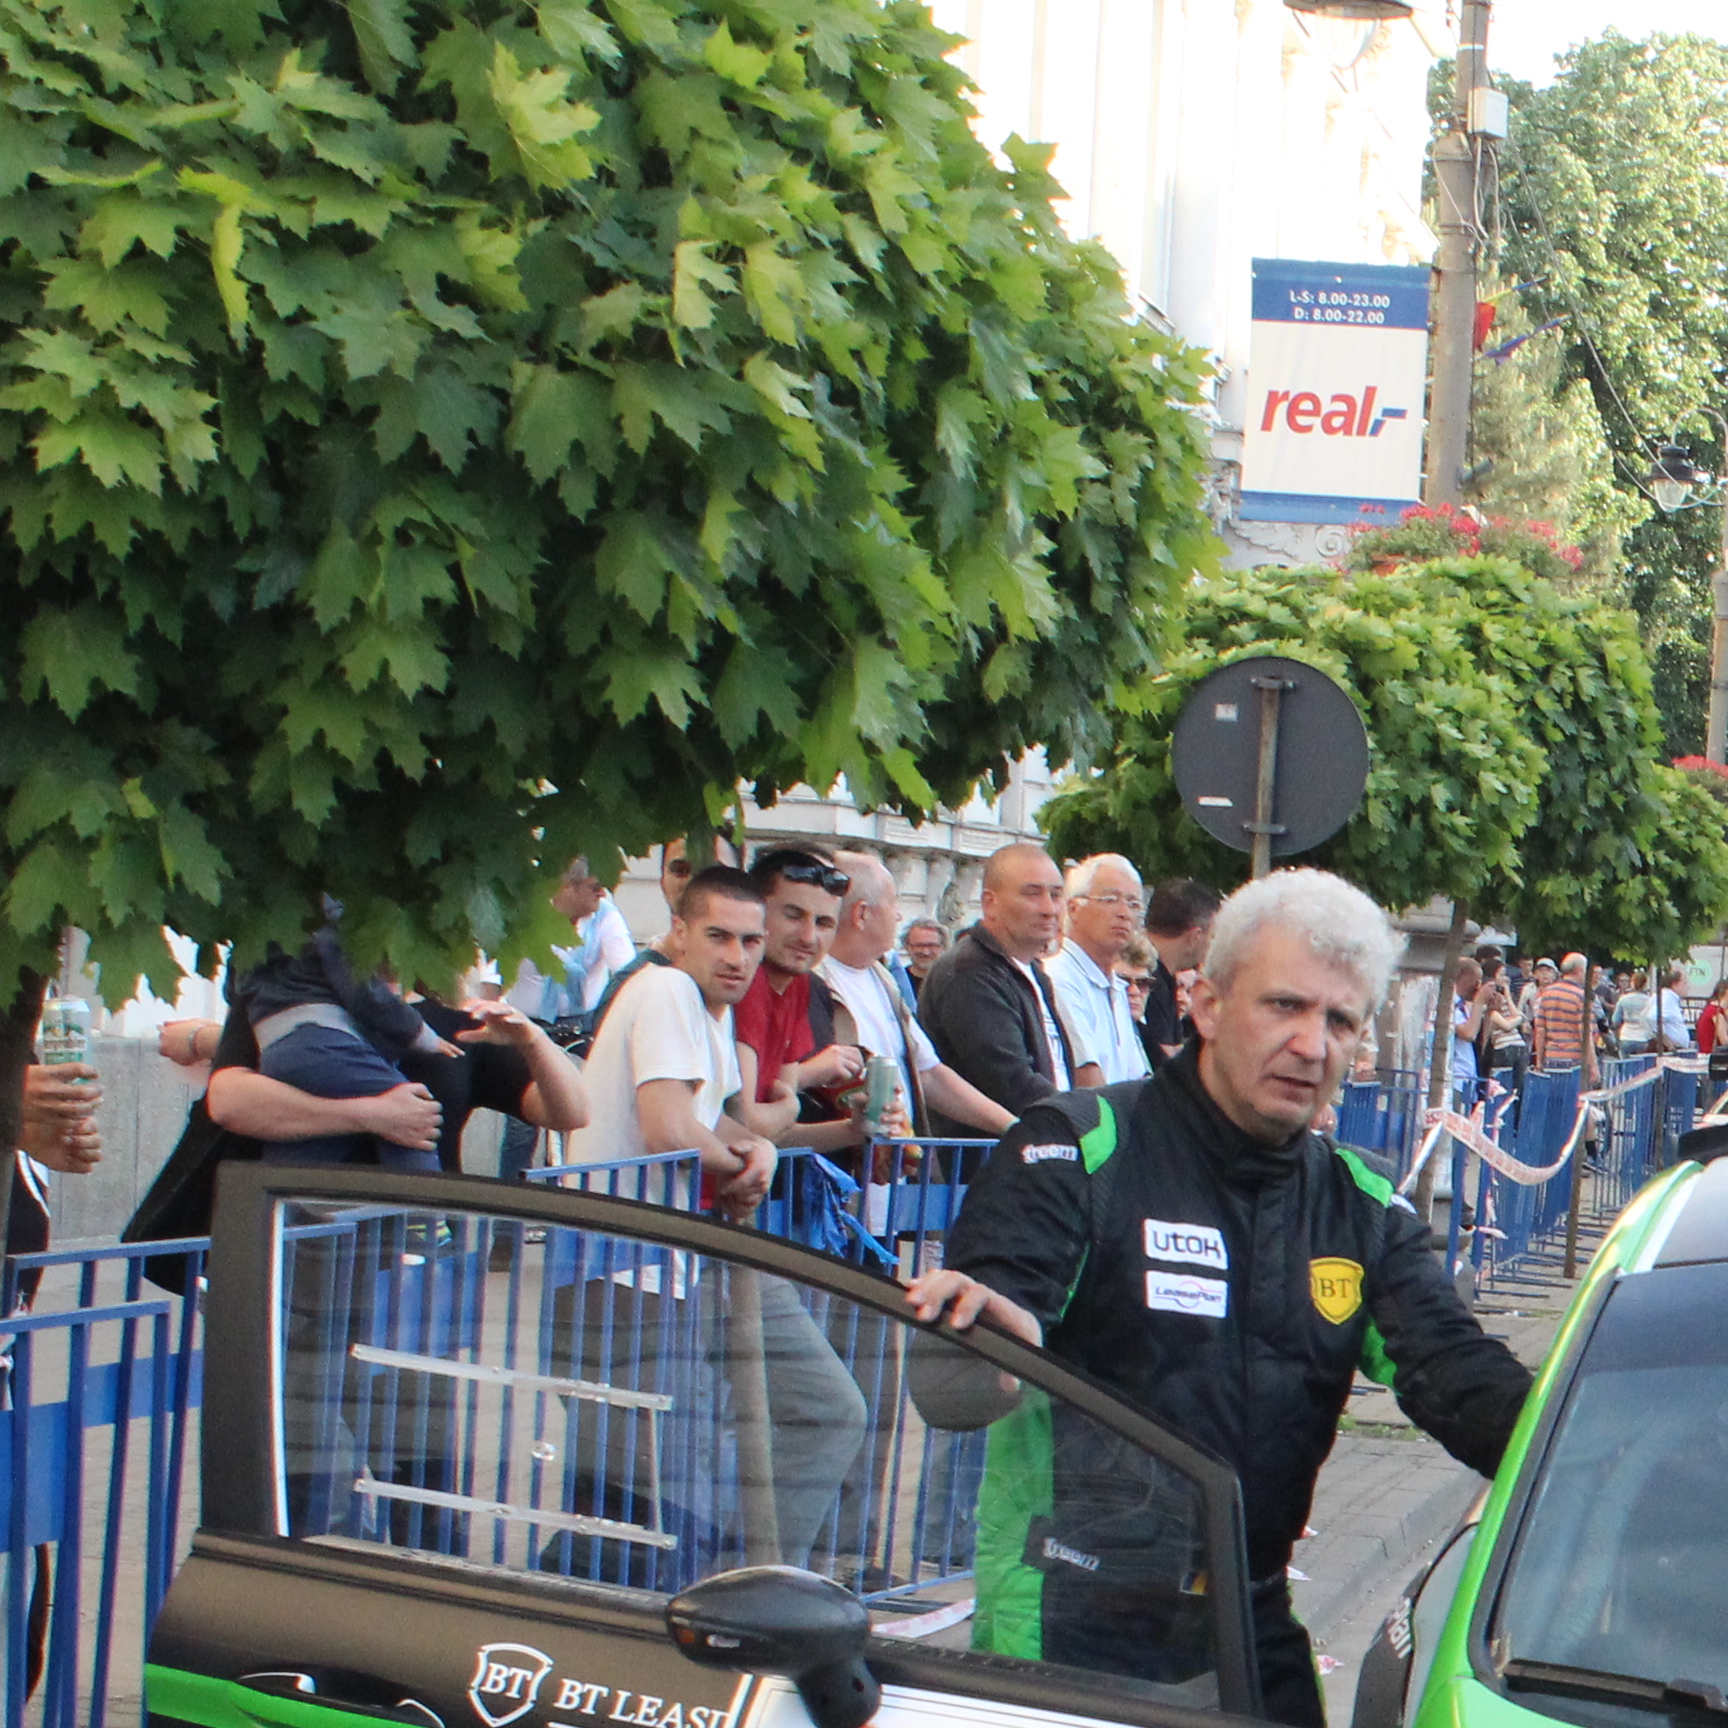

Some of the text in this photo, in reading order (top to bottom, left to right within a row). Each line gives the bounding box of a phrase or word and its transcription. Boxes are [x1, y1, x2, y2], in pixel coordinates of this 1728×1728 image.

[1318, 291, 1390, 308] 8.00-23.00
[1294, 306, 1385, 324] D: 8.00-22.00
[1155, 1286, 1222, 1304] LeasePlan
[1319, 1277, 1351, 1298] BT
[481, 1664, 531, 1700] BT
[555, 1678, 612, 1714] BT
